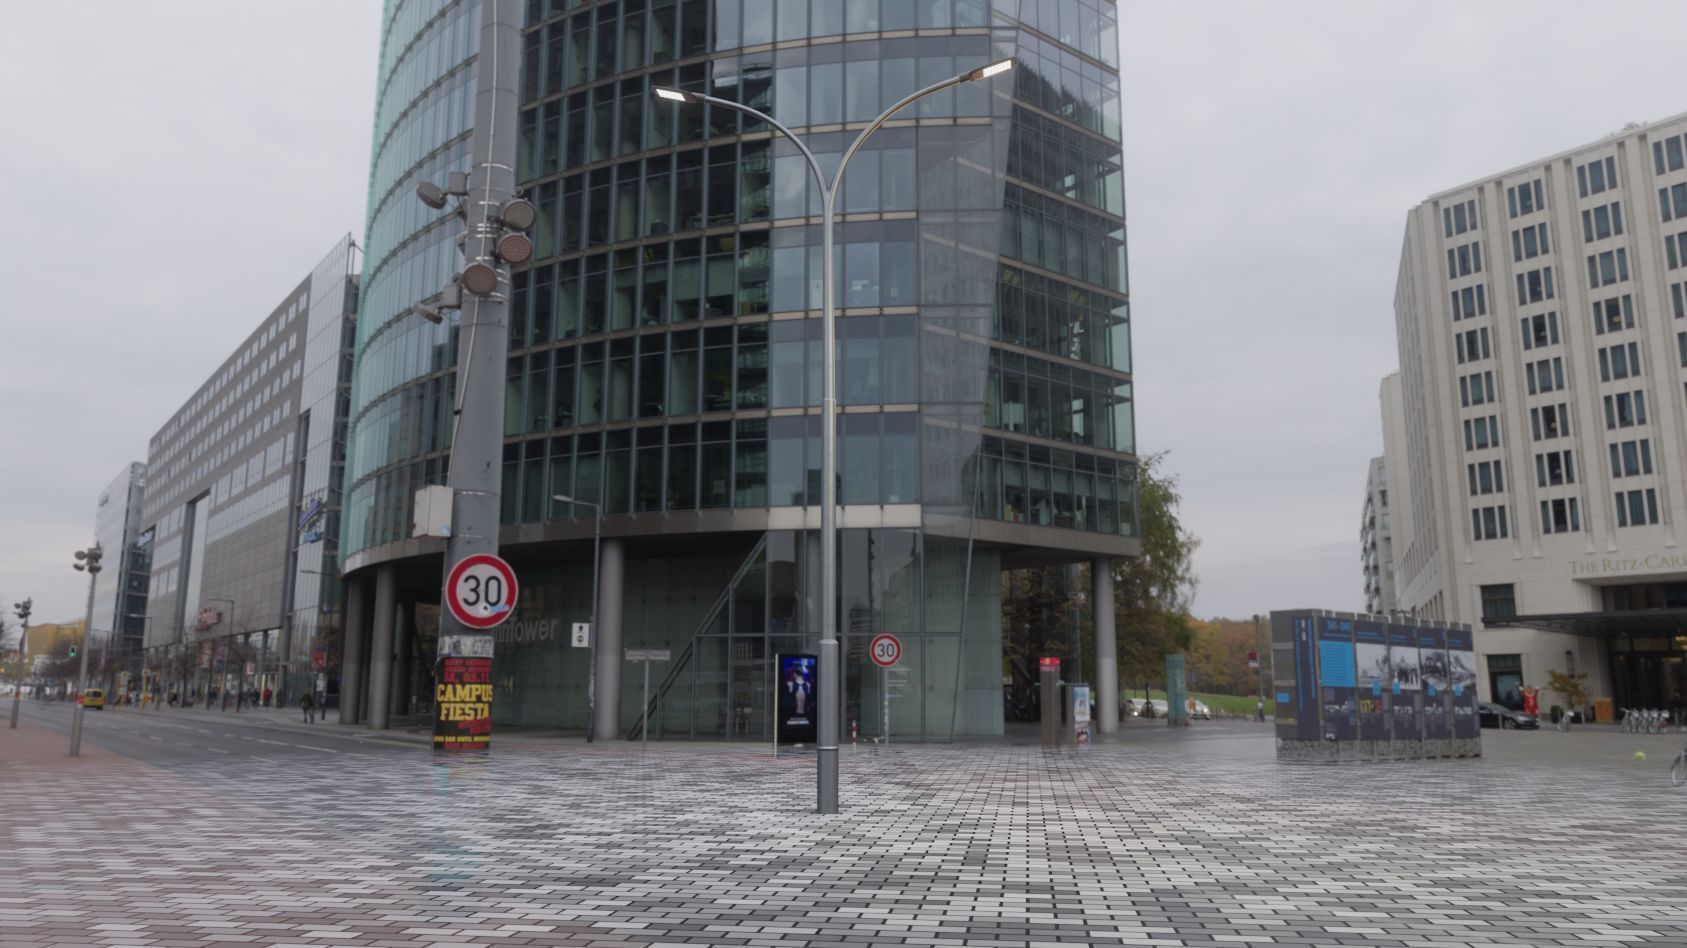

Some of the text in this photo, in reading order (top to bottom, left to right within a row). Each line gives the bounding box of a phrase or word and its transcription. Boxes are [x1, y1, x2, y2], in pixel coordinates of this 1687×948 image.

[463, 575, 502, 607] 30
[877, 642, 895, 658] 30
[440, 703, 490, 721] FIESTA
